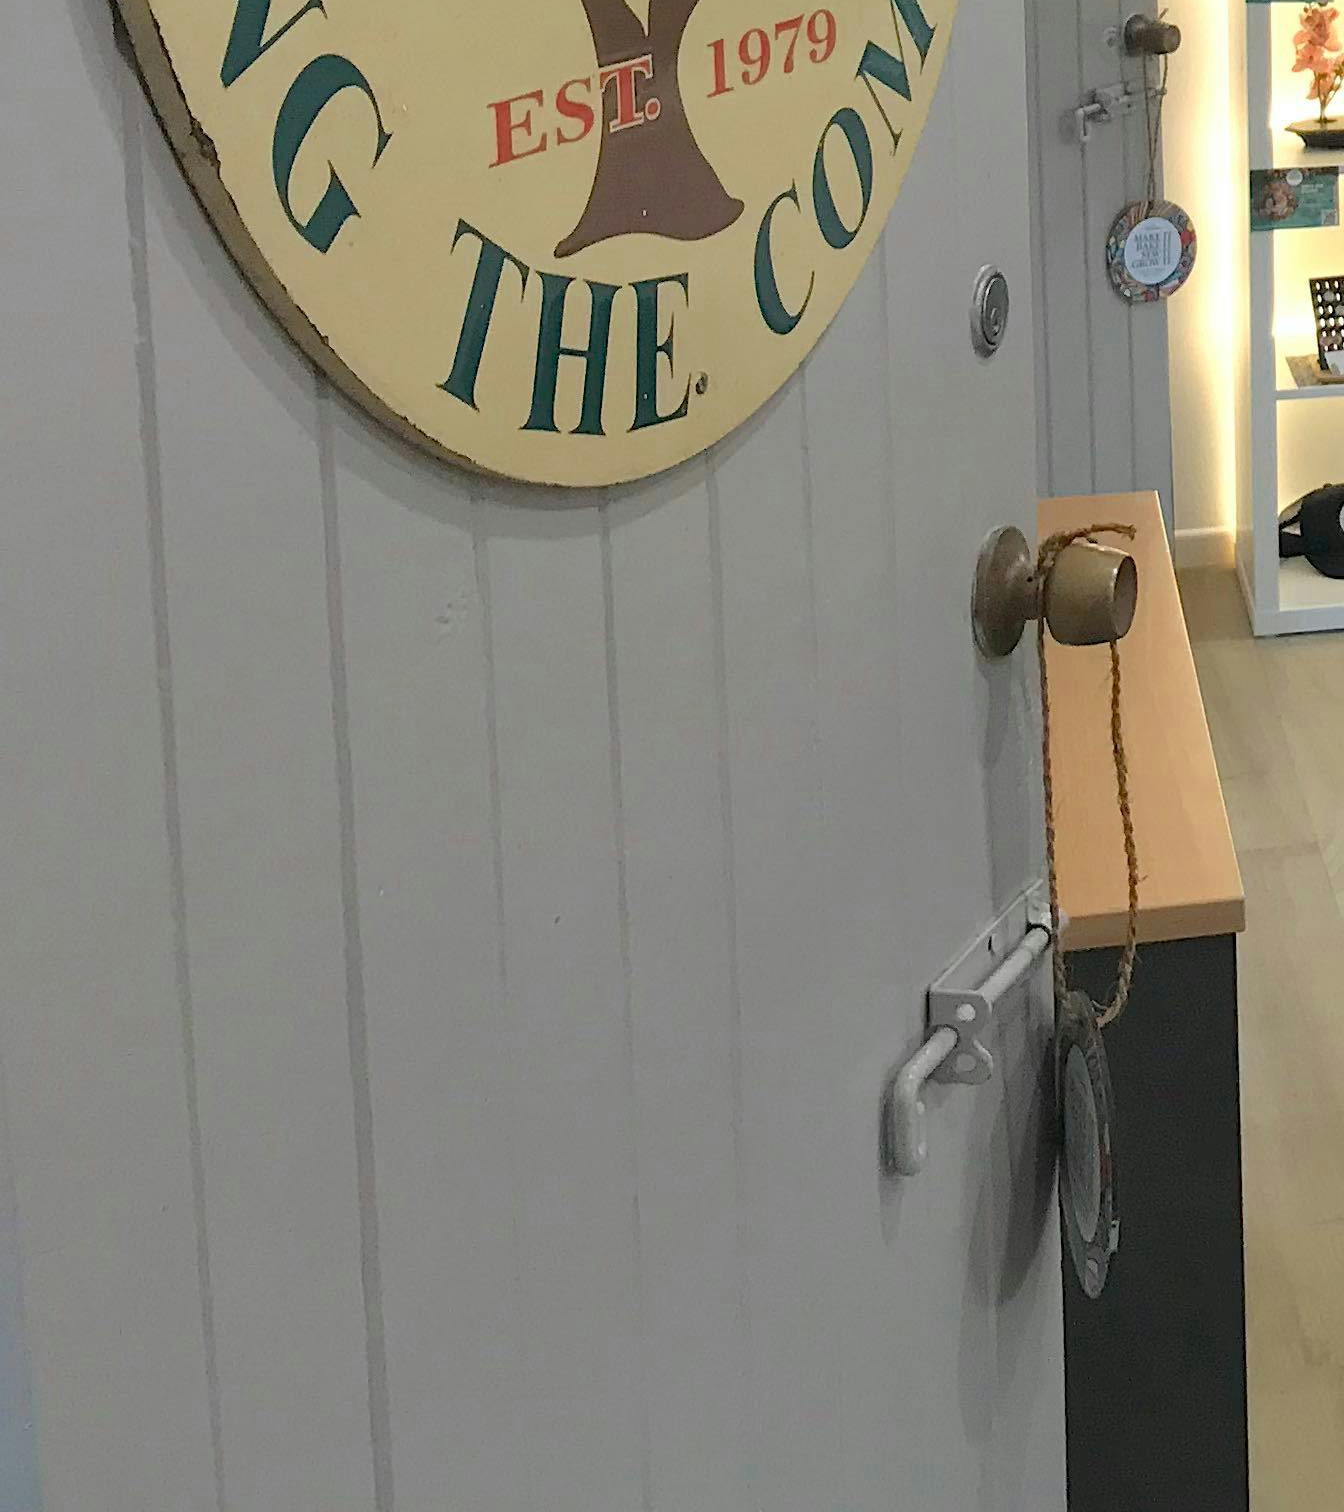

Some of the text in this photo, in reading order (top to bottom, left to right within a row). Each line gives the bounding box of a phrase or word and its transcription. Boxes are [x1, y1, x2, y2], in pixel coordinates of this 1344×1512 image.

[487, 7, 838, 169] EST. 1979
[435, 218, 694, 437] THE
